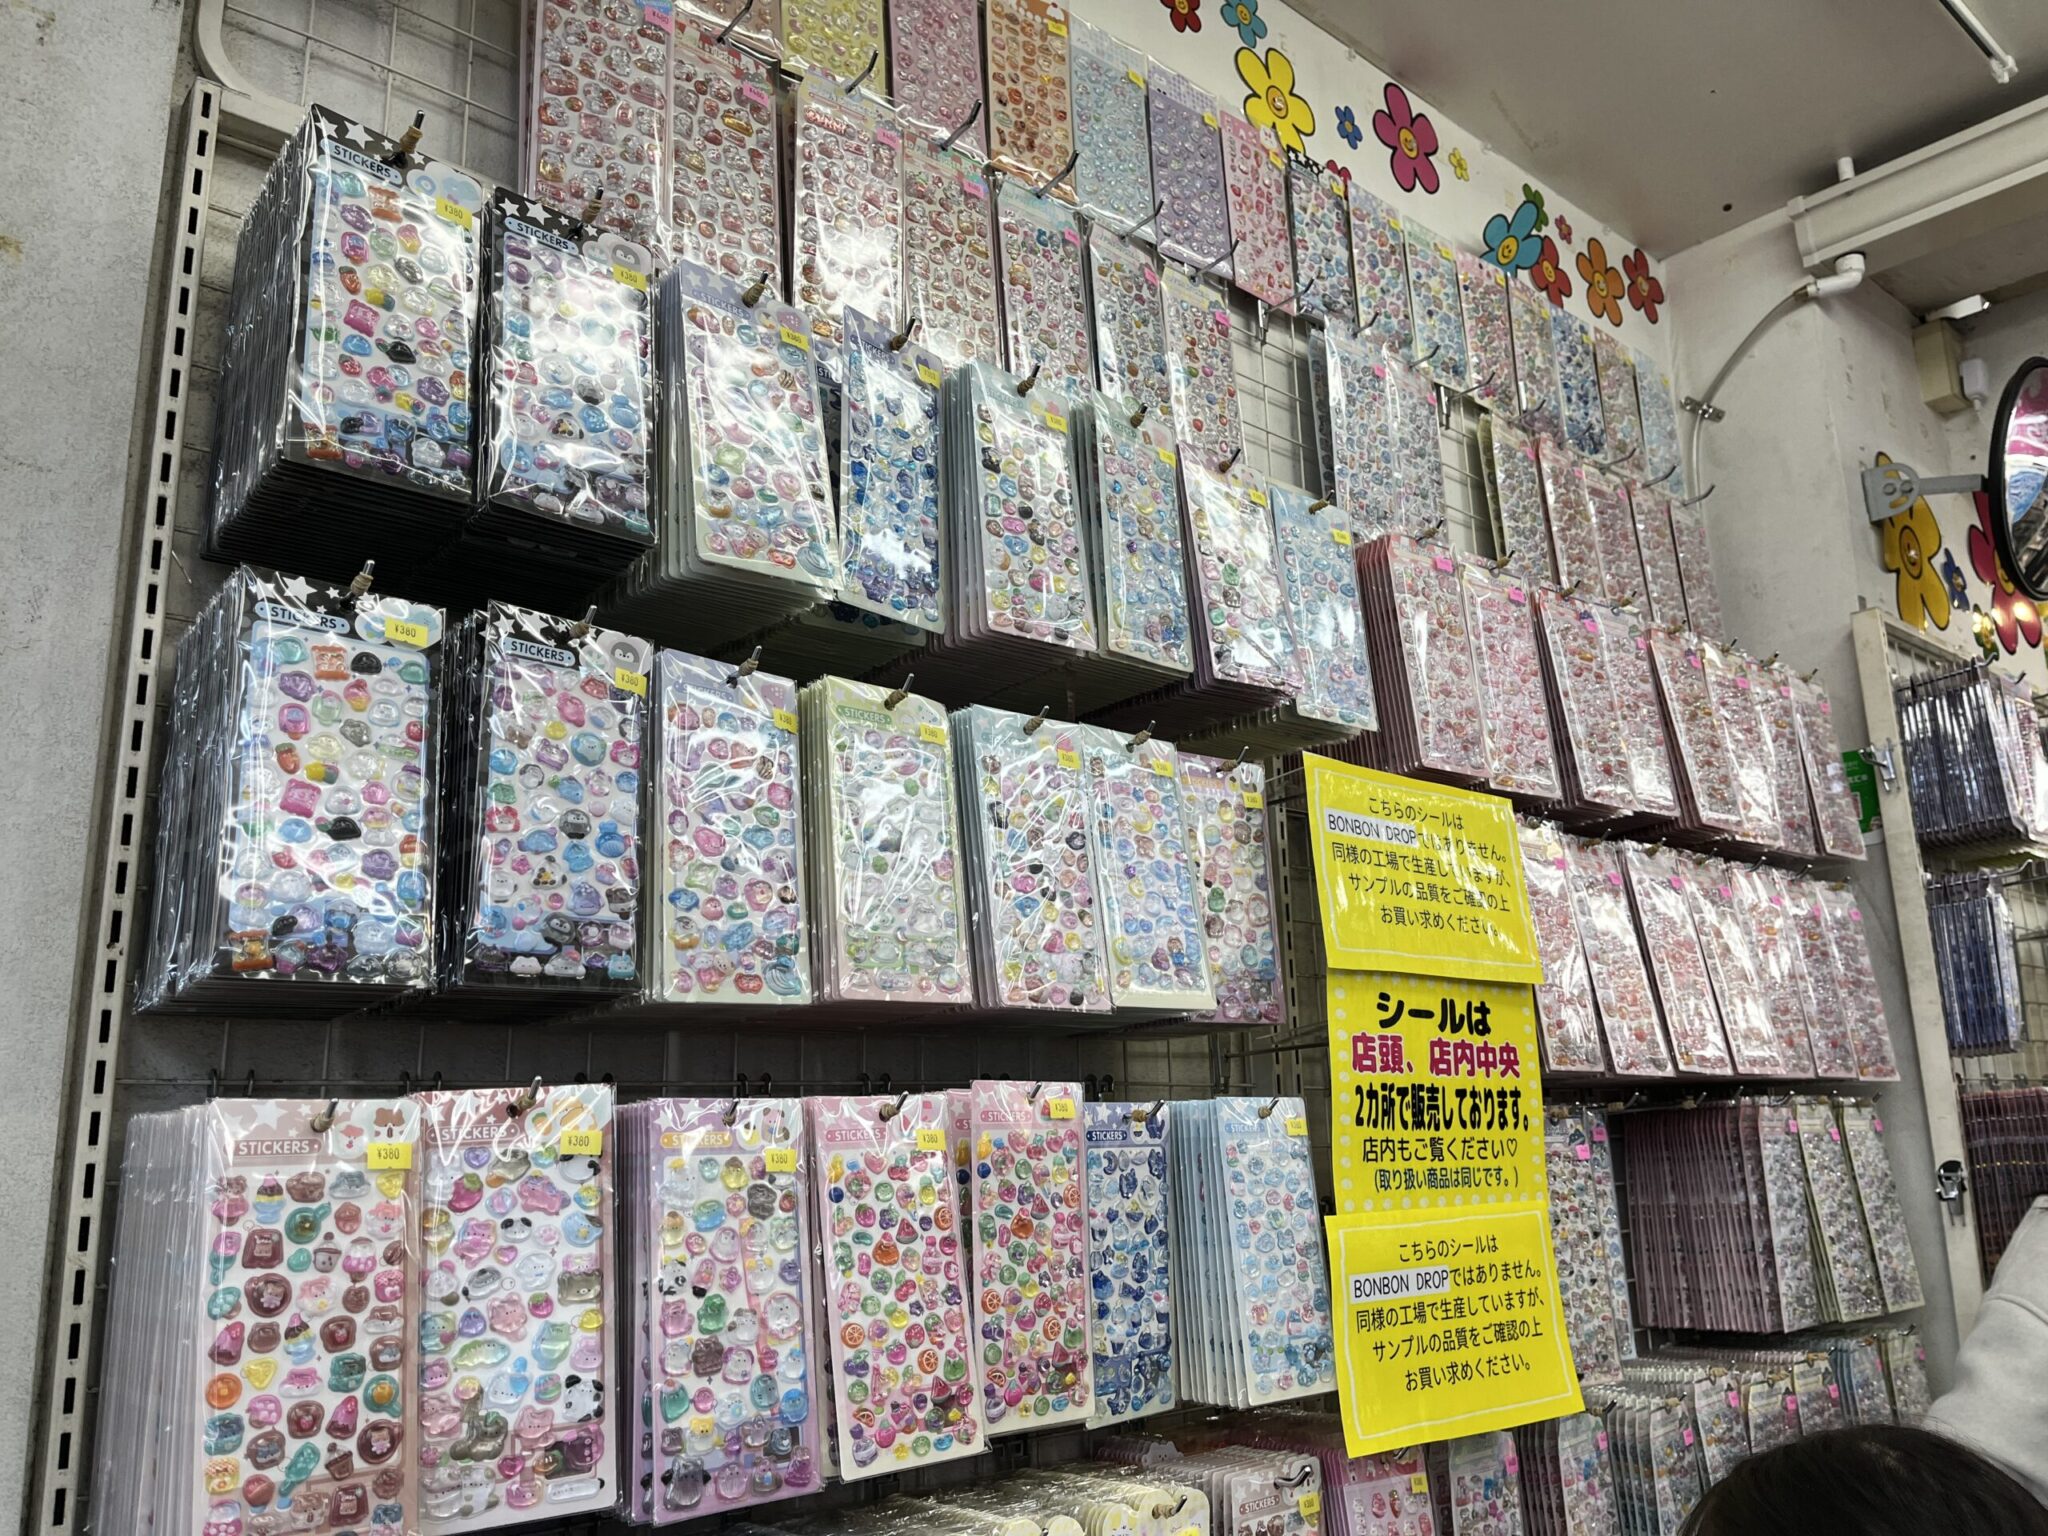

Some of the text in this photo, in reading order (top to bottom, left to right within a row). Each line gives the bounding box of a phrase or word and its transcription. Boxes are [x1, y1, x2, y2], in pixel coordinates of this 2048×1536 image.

[333, 145, 391, 178] STICKERS
[444, 205, 463, 219] ¥380
[517, 223, 569, 250] STICKERS
[620, 269, 638, 283] ¥380
[701, 292, 745, 318] STICKERS
[271, 606, 337, 629] STIRS
[394, 623, 417, 638] ¥380
[511, 641, 565, 662] STICKERS
[621, 673, 639, 687] ¥380
[844, 708, 886, 724] STICKERS
[1369, 798, 1464, 830] こちらのシールは
[1328, 814, 1380, 839] BONBON
[1380, 905, 1498, 937] お買い求めください。
[1376, 992, 1492, 1037] シールは
[1355, 1082, 1530, 1132] 2カ所で販売しております。
[441, 1127, 508, 1141] STICKERS
[568, 1135, 590, 1147] ¥380
[671, 1134, 723, 1147] STERS
[922, 1134, 938, 1144] ¥380
[1091, 1130, 1123, 1141] STICKERS
[238, 1140, 310, 1155] STICKERS
[377, 1148, 400, 1160] ¥380
[771, 1153, 788, 1164] ¥380
[1399, 1234, 1499, 1263] こちらのシールは
[1354, 1274, 1409, 1299] BONBON
[1356, 1286, 1545, 1333] 同様の工場で生産していますが、
[1373, 1316, 1543, 1363] サンプルの品質をご確認の上
[1405, 1352, 1531, 1392] お買い求めください。
[1245, 1496, 1276, 1513] STICKERS
